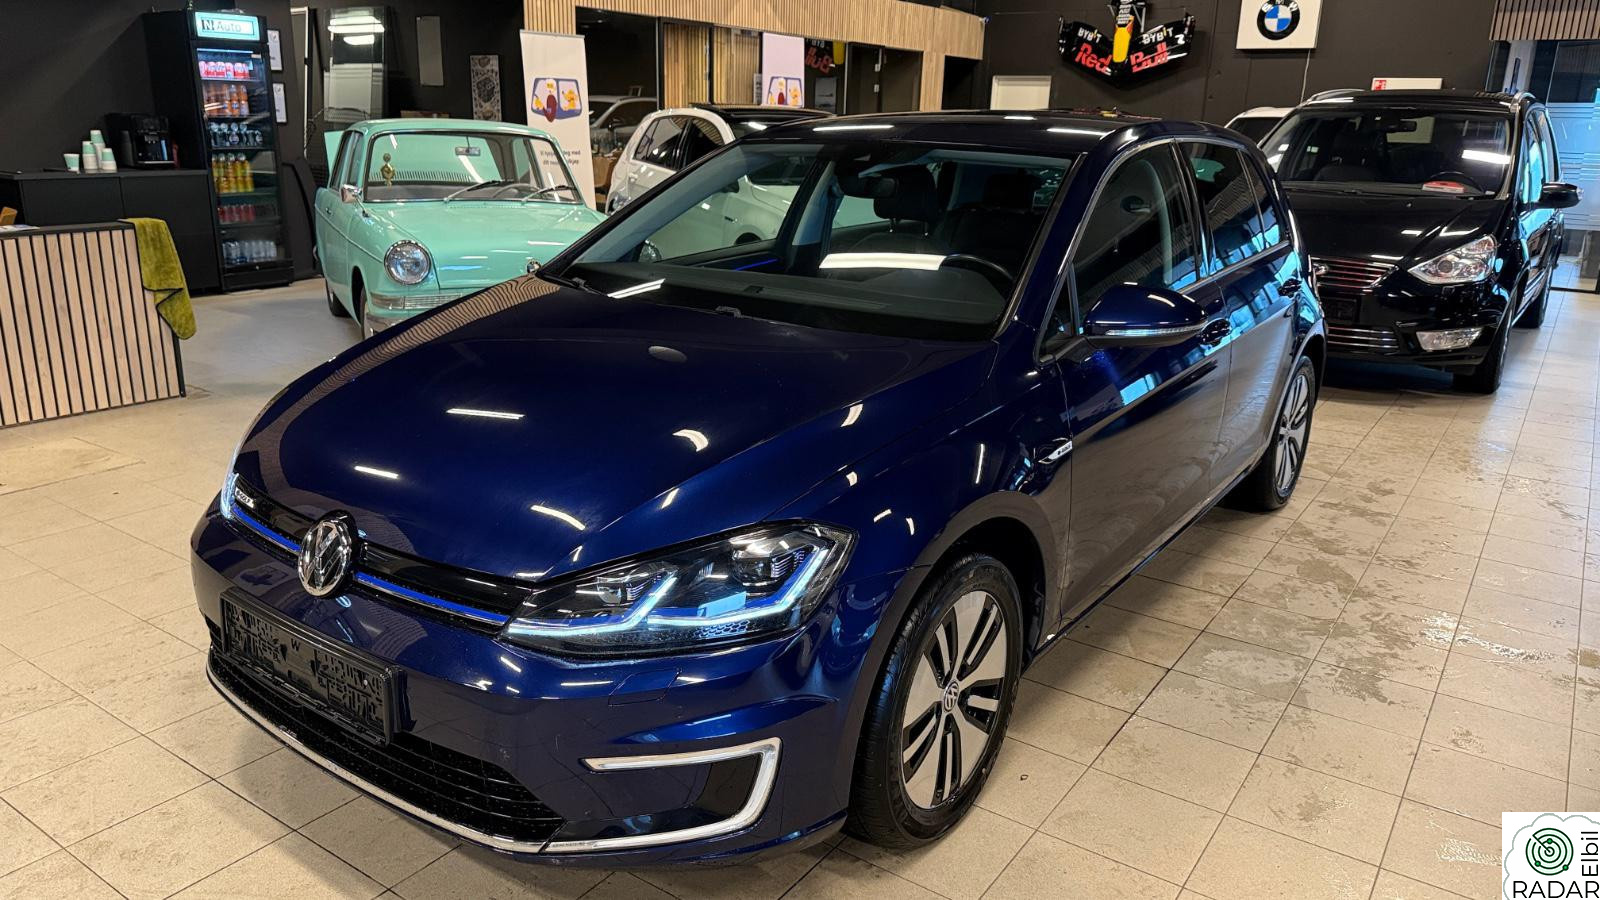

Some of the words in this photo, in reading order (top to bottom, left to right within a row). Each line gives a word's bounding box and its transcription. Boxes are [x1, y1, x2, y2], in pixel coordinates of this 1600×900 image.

[216, 21, 242, 32] Auto
[1078, 27, 1102, 43] BYBIT
[1141, 27, 1174, 45] BYBIT
[1075, 43, 1113, 71] Red
[1130, 42, 1169, 73] Bull
